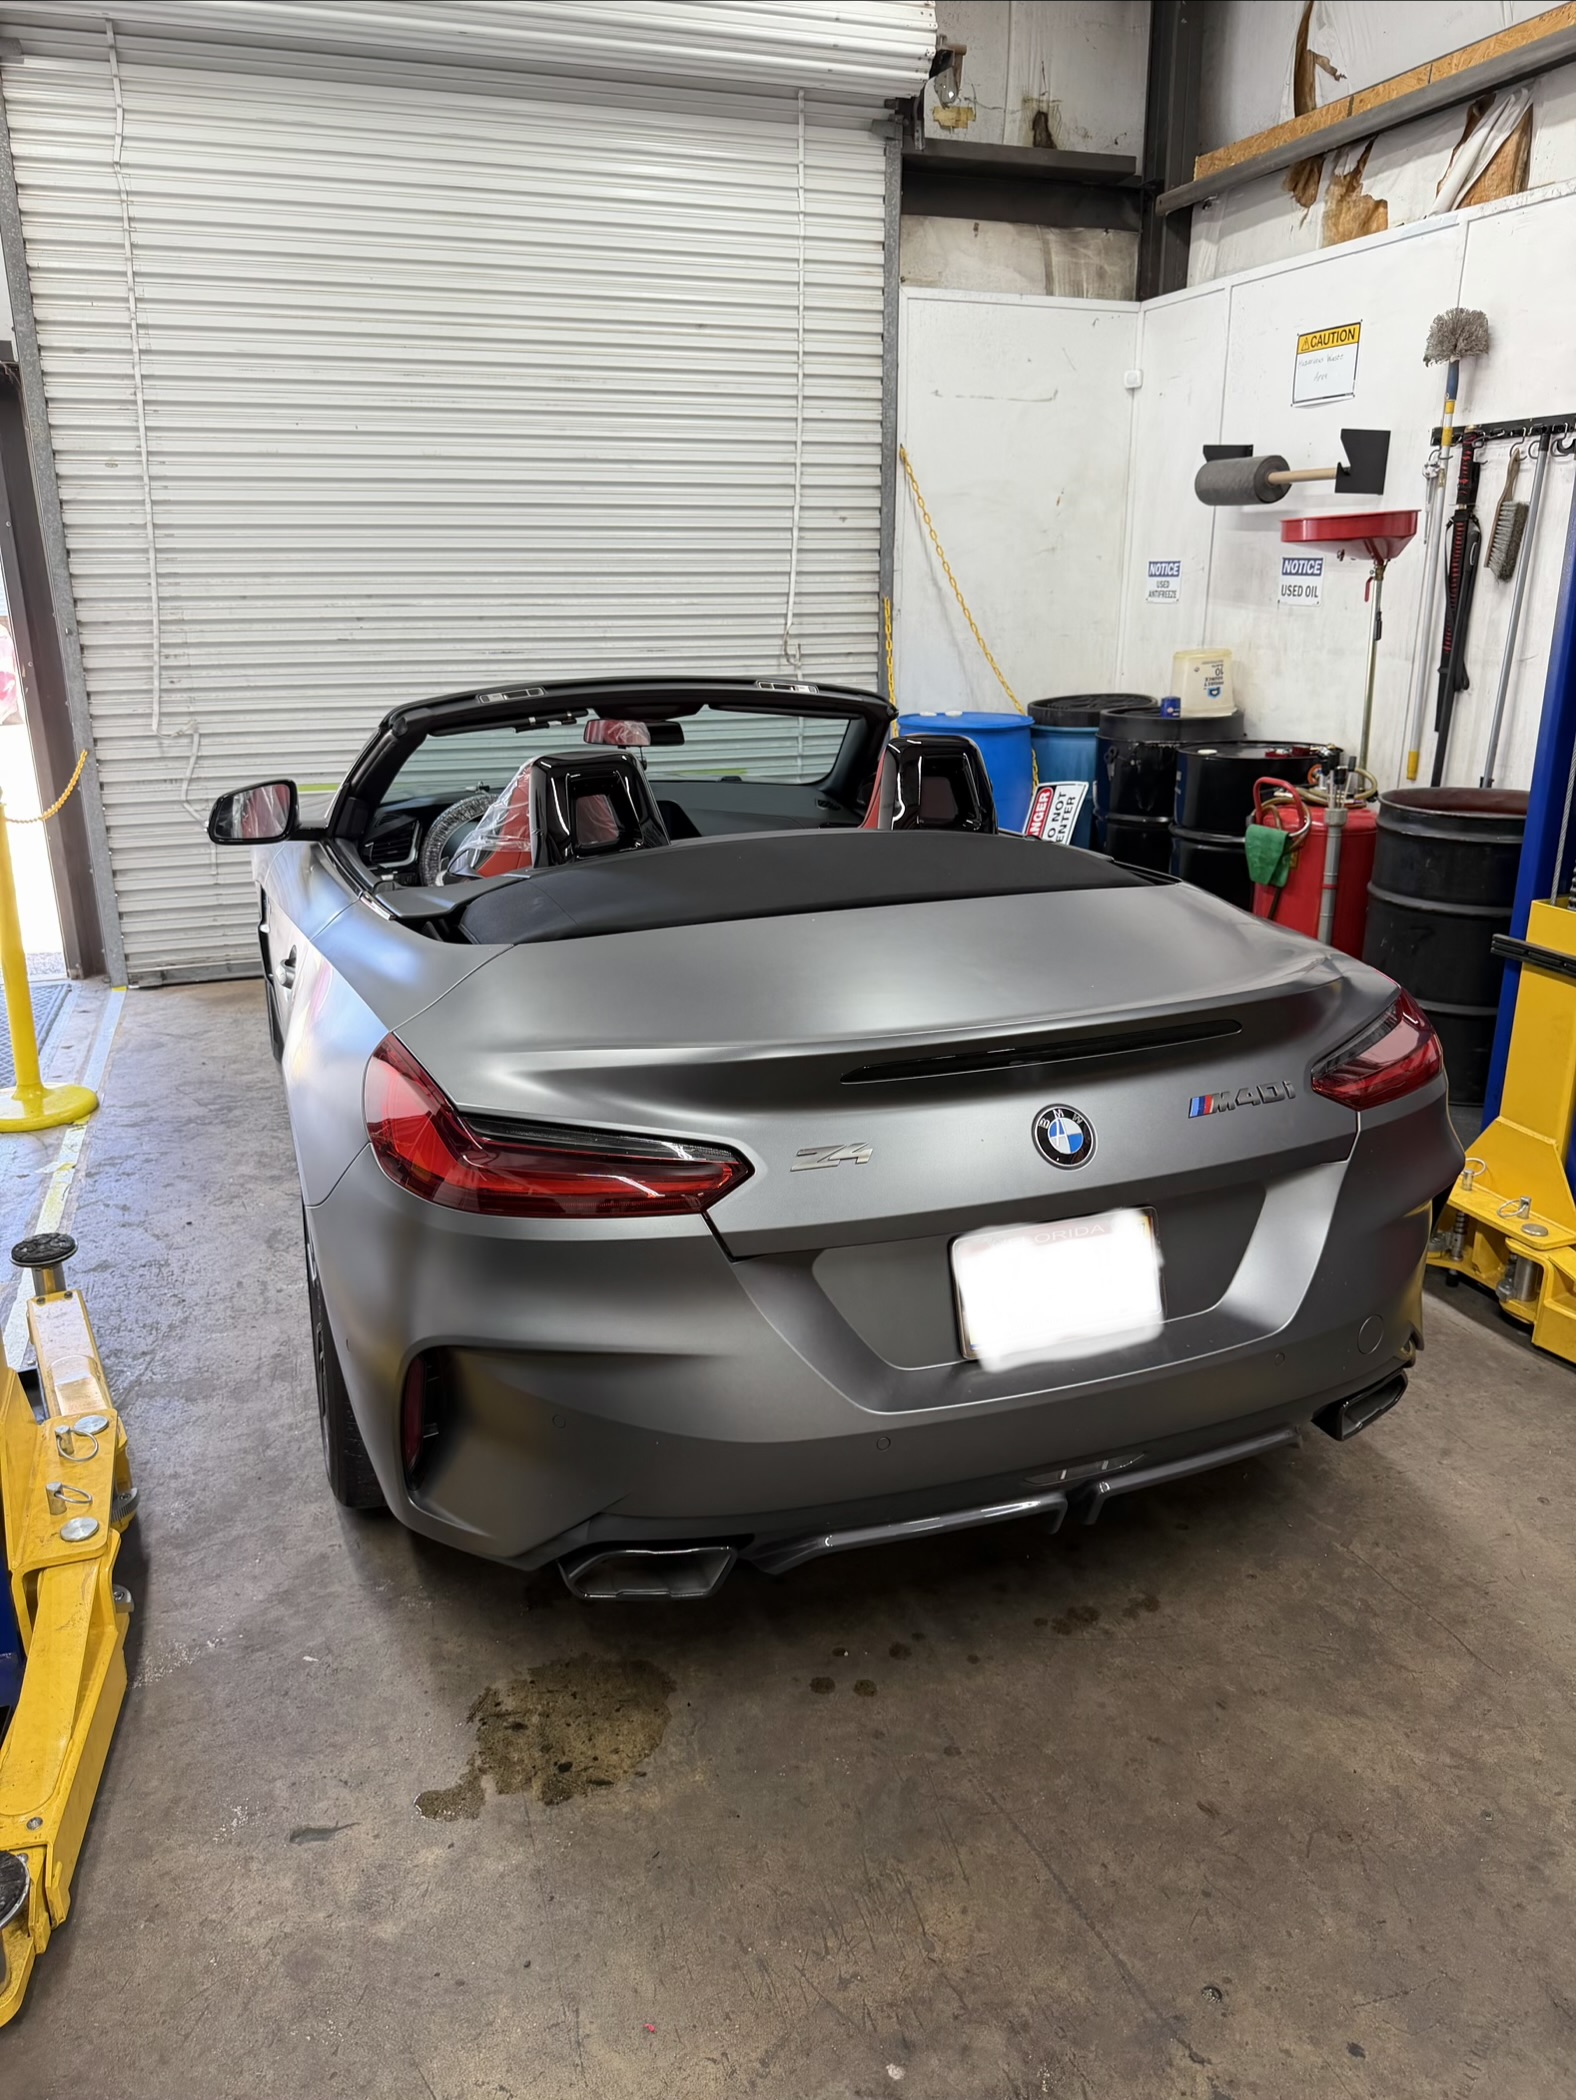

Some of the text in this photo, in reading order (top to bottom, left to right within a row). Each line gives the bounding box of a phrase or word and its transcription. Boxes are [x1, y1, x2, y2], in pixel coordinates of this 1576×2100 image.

[1310, 327, 1356, 348] CAUTION
[1150, 563, 1179, 575] NOTICE
[1283, 560, 1322, 574] NOTICE
[1148, 590, 1177, 599] ANTIFREEZE
[1156, 580, 1170, 589] USED
[1281, 584, 1319, 598] USED OIL
[1030, 791, 1050, 836] NGER
[1051, 791, 1066, 822] NOT
[1056, 796, 1076, 842] ENTER
[1038, 1108, 1083, 1130] BMW
[790, 1142, 873, 1172] Z4
[1023, 1223, 1105, 1245] ORIDA
